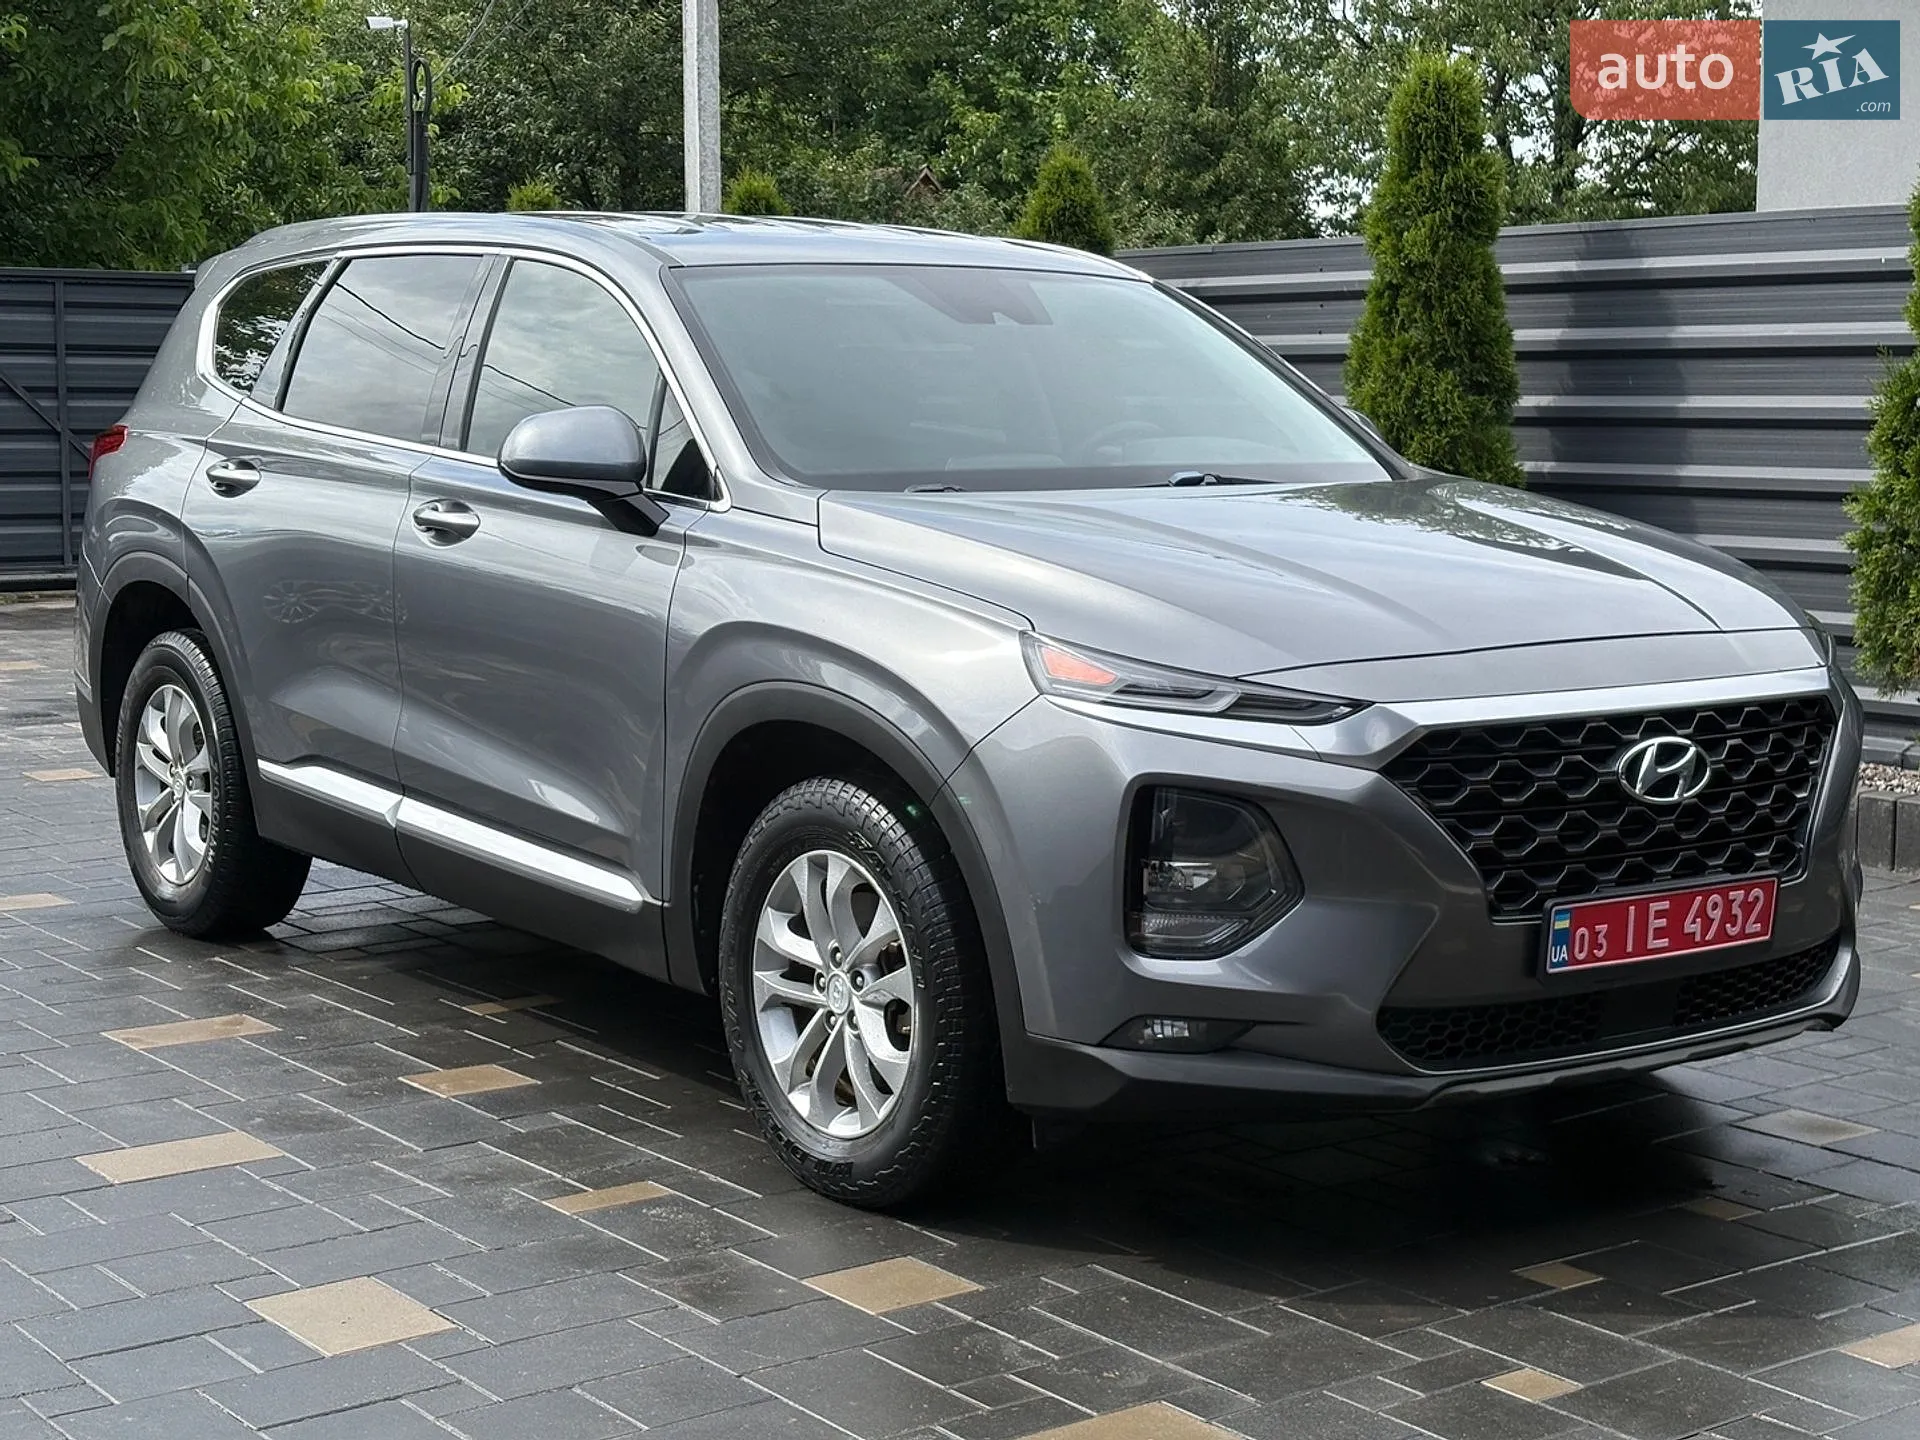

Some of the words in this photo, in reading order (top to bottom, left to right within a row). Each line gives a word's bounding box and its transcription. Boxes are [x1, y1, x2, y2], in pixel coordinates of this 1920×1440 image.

[1574, 924, 1609, 961] 03
[1626, 901, 1670, 952] IE
[1684, 888, 1765, 942] 4932
[1551, 946, 1568, 962] UA
